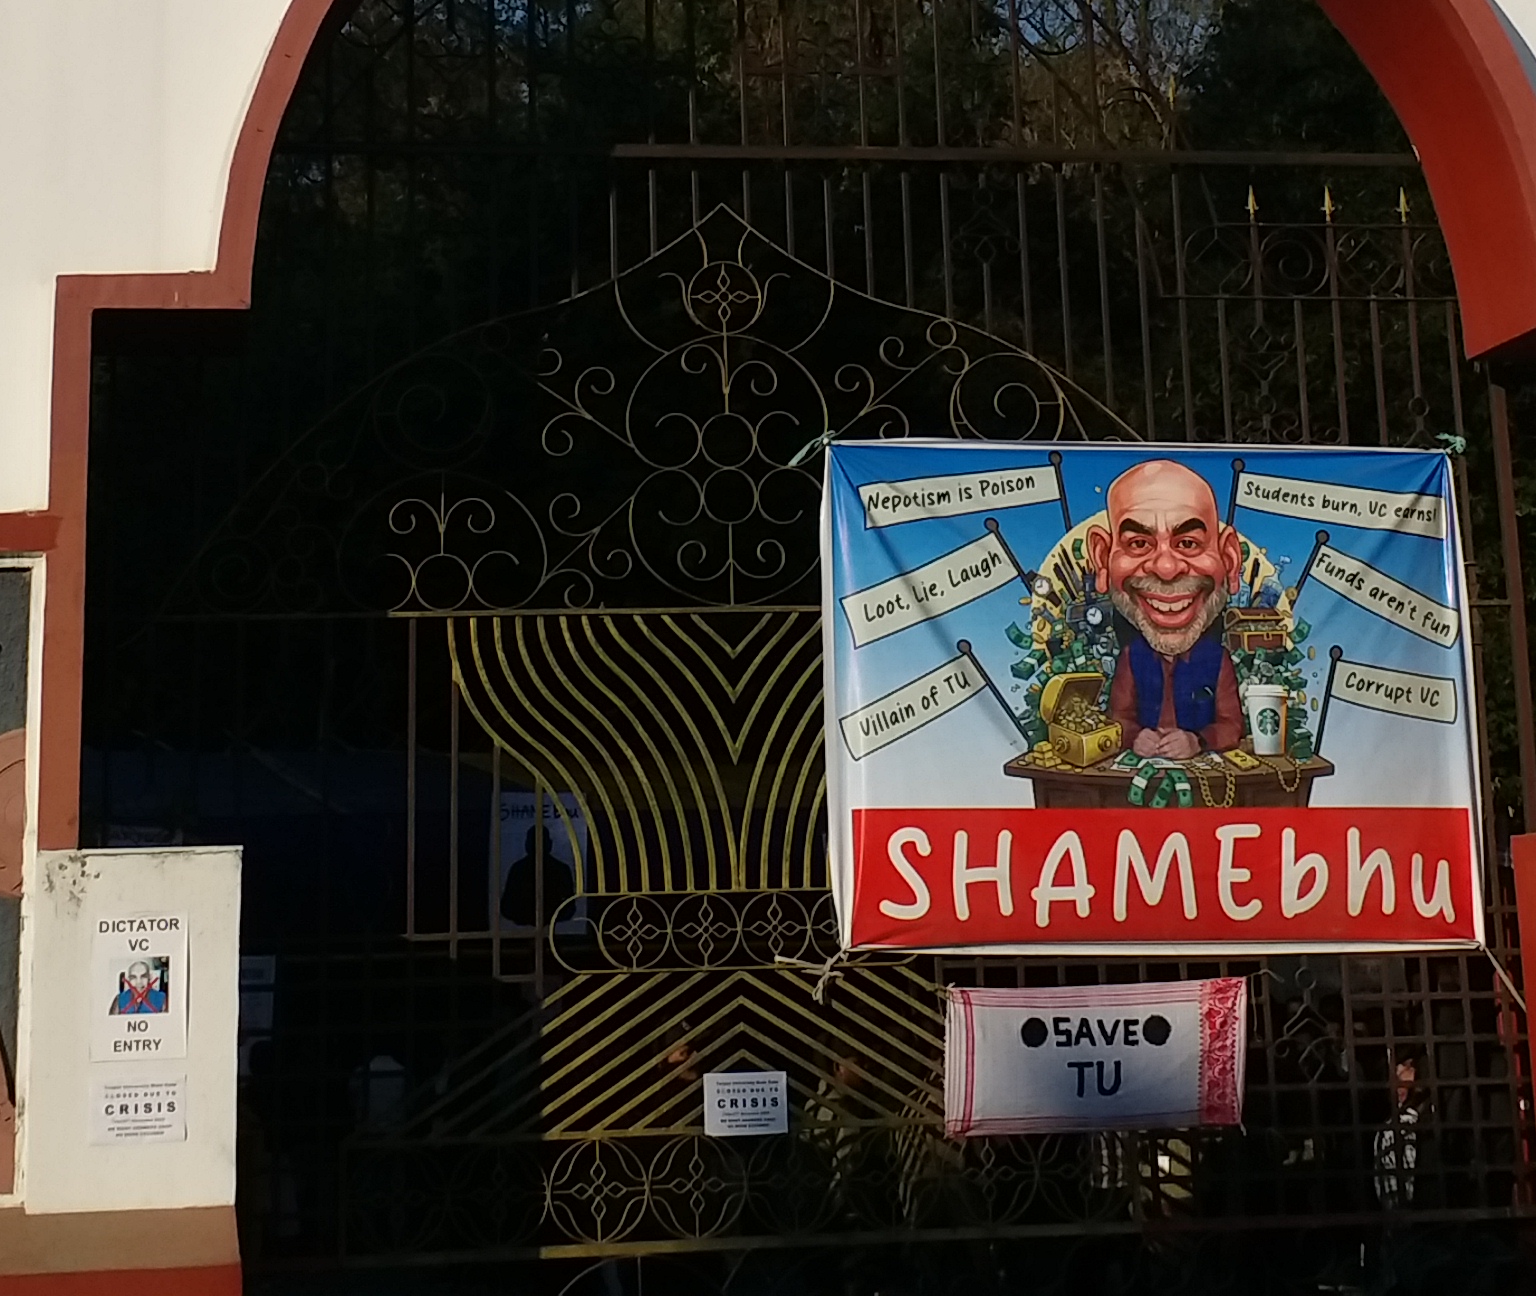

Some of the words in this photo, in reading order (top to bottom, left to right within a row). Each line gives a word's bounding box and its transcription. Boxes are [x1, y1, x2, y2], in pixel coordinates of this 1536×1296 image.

[866, 491, 951, 513] Nepotism
[958, 482, 974, 503] is
[978, 475, 1036, 498] Poison
[1244, 480, 1315, 508] Students
[1322, 494, 1363, 517] burn,
[1369, 500, 1388, 517] VC
[863, 592, 911, 623] Loot,
[947, 550, 1003, 588] Laugh
[1316, 552, 1366, 592] Funds
[1369, 587, 1418, 621] aren't
[1422, 611, 1452, 639] fun
[859, 701, 916, 738] Villain
[921, 685, 940, 711] of
[943, 670, 972, 696] TU
[1345, 671, 1413, 704] Corrupt
[1420, 687, 1441, 708] VC
[879, 823, 1457, 929] SHAMEbhu
[98, 917, 181, 935] DICTATOR
[128, 938, 150, 952] VC
[126, 1020, 149, 1033] NO
[1053, 1015, 1141, 1049] SAVE
[113, 1038, 163, 1053] ENTRY
[1066, 1060, 1123, 1099] TU
[105, 1100, 176, 1116] CRISIS
[717, 1096, 779, 1110] CRISIS
